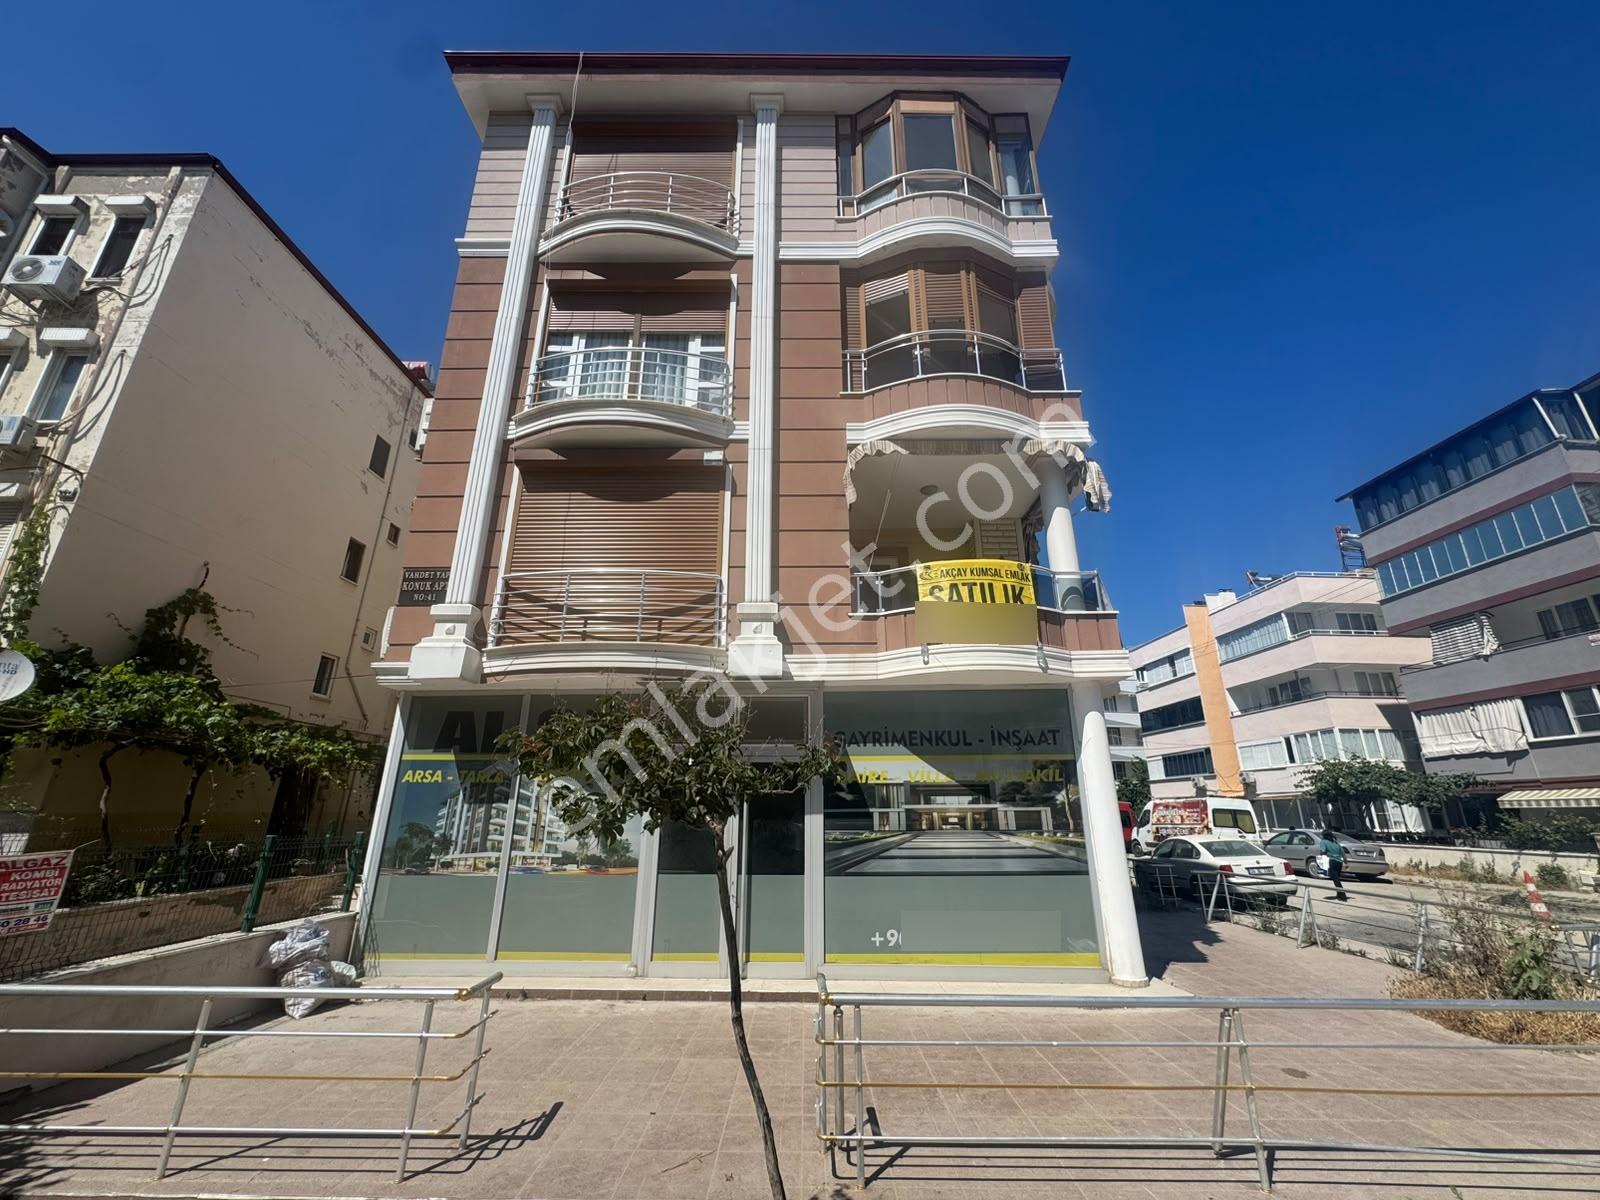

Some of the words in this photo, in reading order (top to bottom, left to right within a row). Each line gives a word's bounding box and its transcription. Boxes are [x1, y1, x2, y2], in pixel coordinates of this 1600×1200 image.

[405, 571, 435, 579] VAHDET
[437, 571, 451, 579] YAP
[940, 568, 967, 579] AKÇAY
[970, 567, 1003, 579] KUMSAL
[1005, 570, 1031, 582] EMLAK
[402, 581, 432, 591] KONUK
[991, 726, 1061, 751] İNŞAAT
[402, 770, 443, 784] ARSA
[459, 770, 504, 784] TARLA
